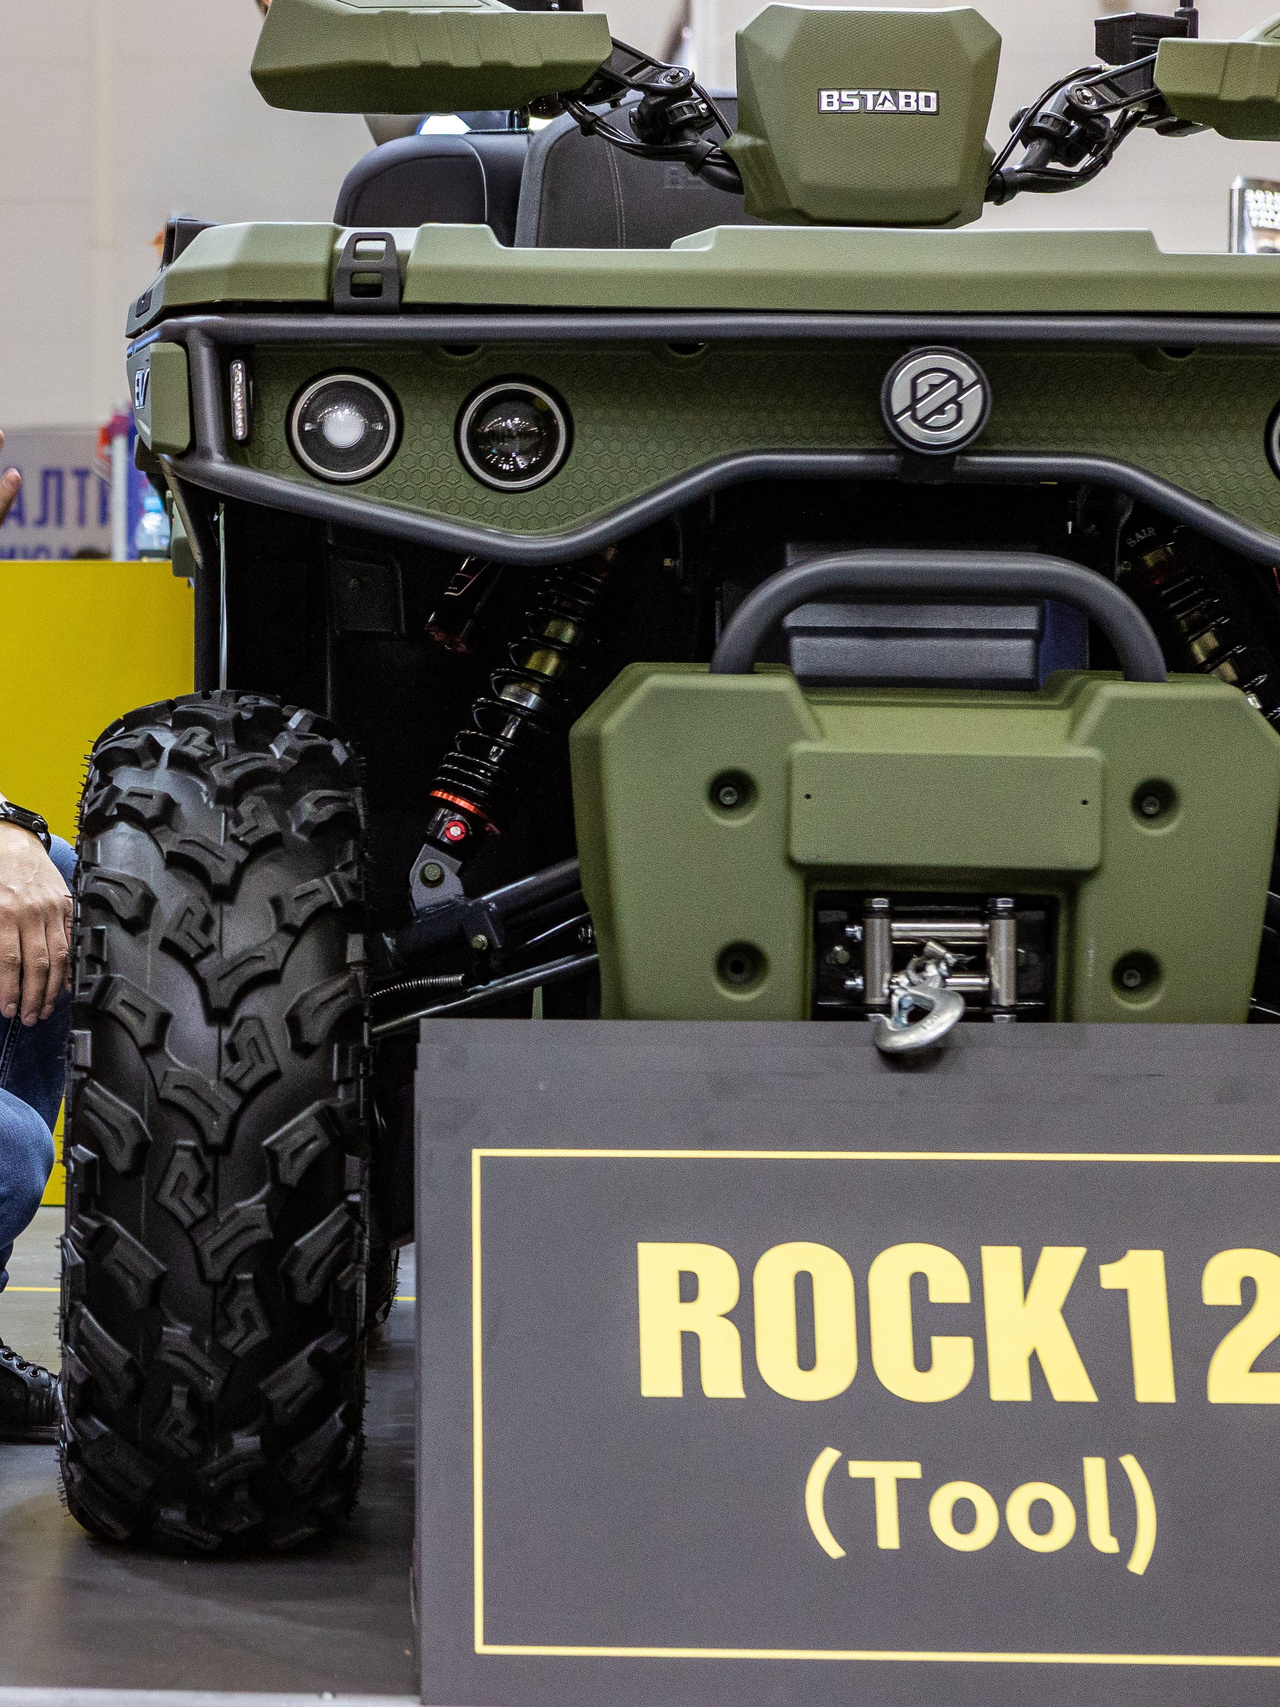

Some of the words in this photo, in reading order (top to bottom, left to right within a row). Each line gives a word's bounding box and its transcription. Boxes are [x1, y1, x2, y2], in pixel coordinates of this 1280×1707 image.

[819, 89, 938, 113] BSTABO
[636, 1241, 1280, 1405] ROCK12
[804, 1446, 1158, 1577] (Tool)
